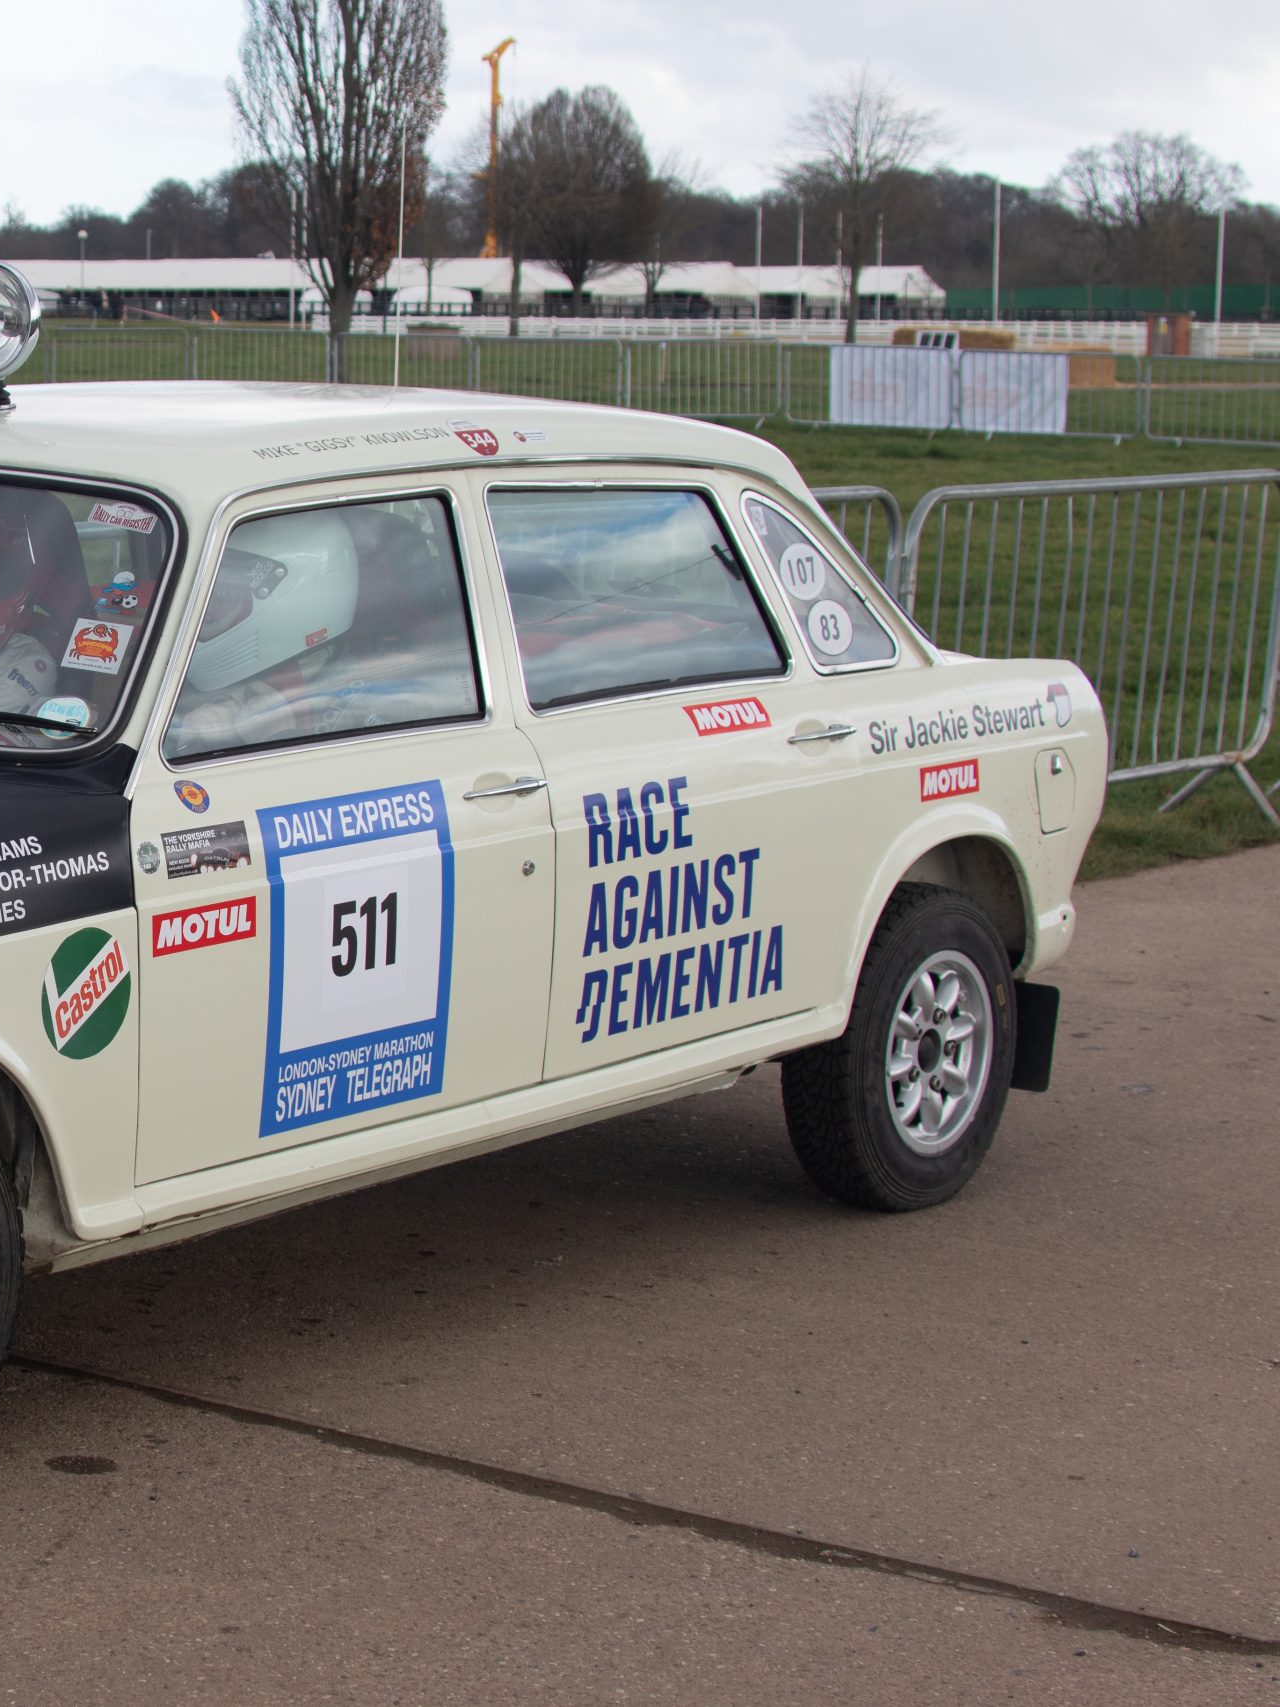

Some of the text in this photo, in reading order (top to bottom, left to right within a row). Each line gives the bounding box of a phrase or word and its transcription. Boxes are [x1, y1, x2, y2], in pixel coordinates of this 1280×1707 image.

[253, 426, 451, 460] MIKE "GIGSY" KNOWLSON
[462, 431, 497, 449] 344
[92, 504, 154, 531] RALLY CAR REGISTER
[787, 556, 815, 586] 107
[820, 614, 841, 641] 83
[692, 701, 767, 730] MOTUL
[869, 698, 1045, 754] Sir Jackie Stewart
[923, 764, 977, 796] MOTUL
[164, 829, 216, 844] THE YORKSHIRE
[273, 791, 434, 849] DAILY EXPRESS
[582, 776, 693, 868] RACE
[166, 839, 211, 854] RALLY MAFIA
[582, 848, 760, 957] AGAINST
[156, 903, 252, 950] MOTUL
[331, 892, 398, 977] 511
[55, 939, 124, 1039] Castrol
[575, 925, 783, 1043] DEMENTIA
[278, 1031, 434, 1083] LONDON-SYDNEY MARATHON
[275, 1052, 433, 1122] SYDNEY TELEGRAPH
